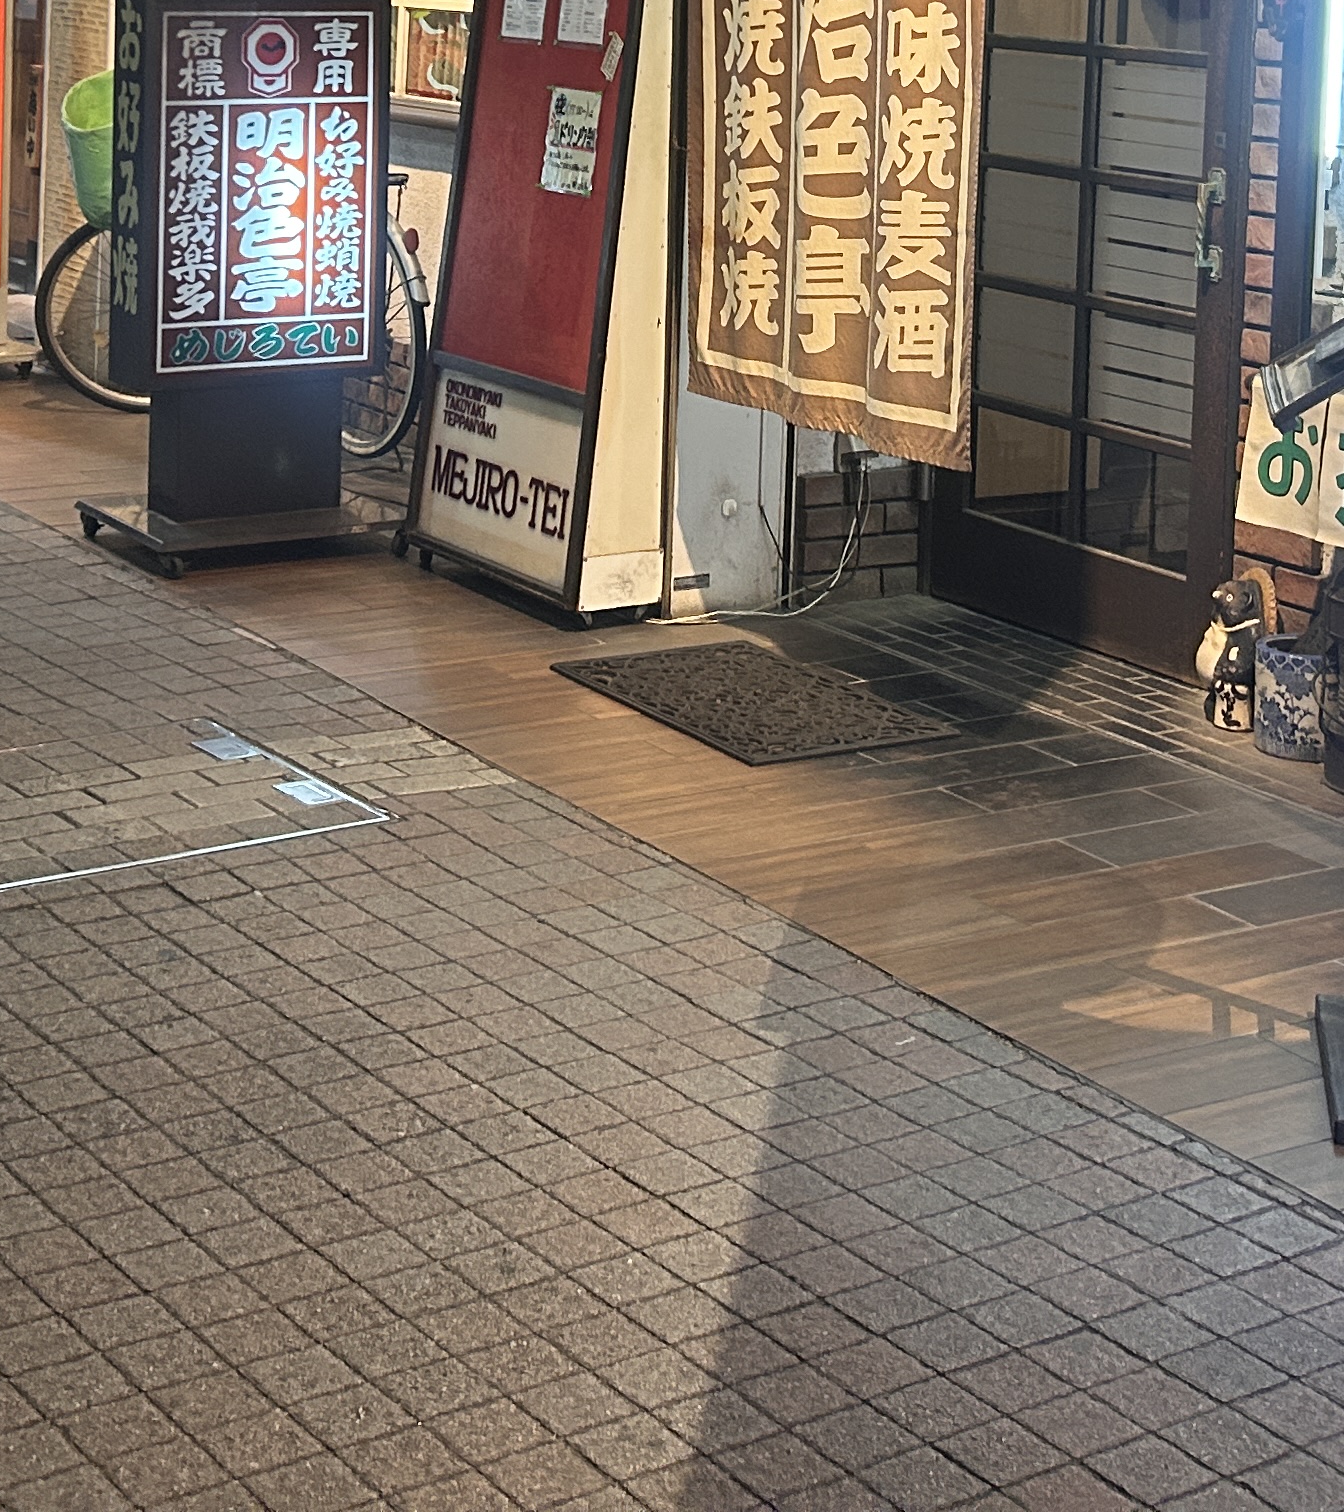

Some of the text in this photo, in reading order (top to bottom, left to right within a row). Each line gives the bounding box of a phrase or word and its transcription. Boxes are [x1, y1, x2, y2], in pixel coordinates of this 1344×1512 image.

[176, 20, 229, 98] 商標
[312, 17, 360, 95] 専用
[167, 110, 221, 321] 鉄板焼我楽多
[230, 107, 306, 314] 明治色亭
[313, 105, 365, 309] お好み焼蛸焼
[170, 321, 359, 364] めじろてい
[443, 409, 497, 439] TEPPANYAKI
[445, 393, 487, 420] TAKOYAKI
[446, 378, 503, 408] OKONOMIYAKI
[431, 444, 570, 540] MEJIRO-TEI
